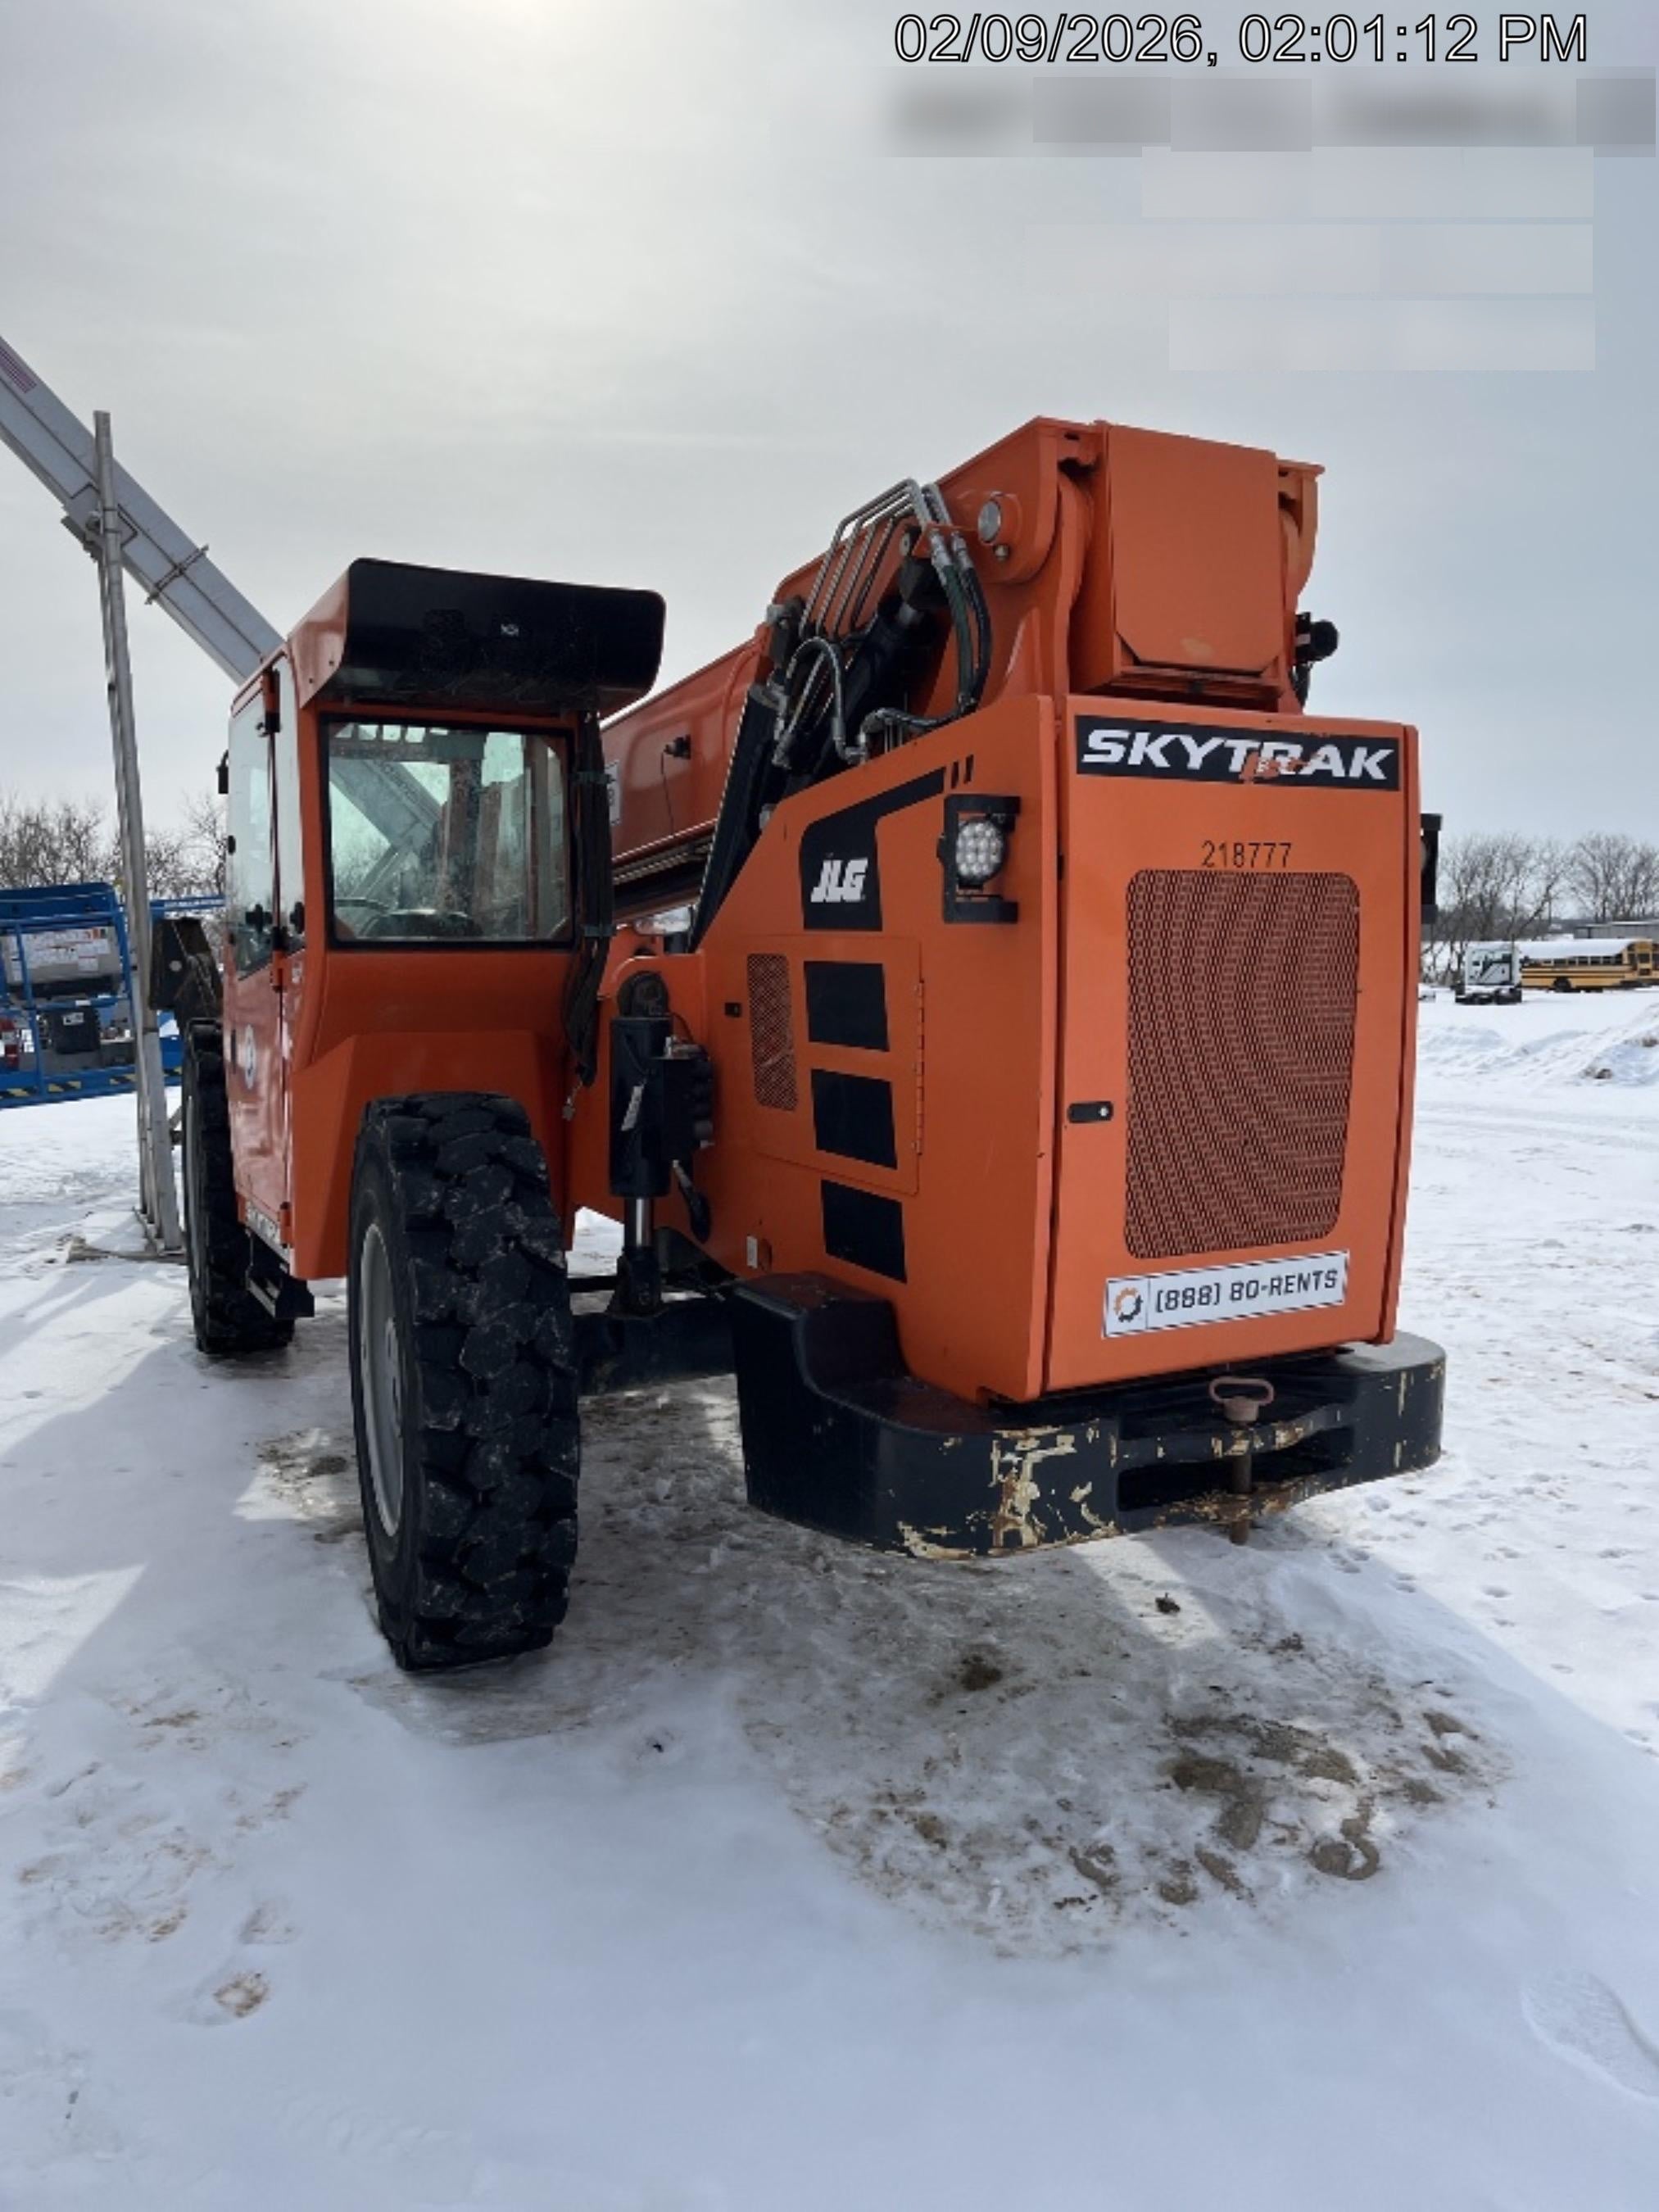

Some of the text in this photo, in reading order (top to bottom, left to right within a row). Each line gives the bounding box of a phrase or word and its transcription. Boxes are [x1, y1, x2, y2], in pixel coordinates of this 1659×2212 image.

[1081, 728, 1394, 781] SKYTRAK
[1201, 839, 1293, 869] 218777
[810, 857, 868, 903] JLG
